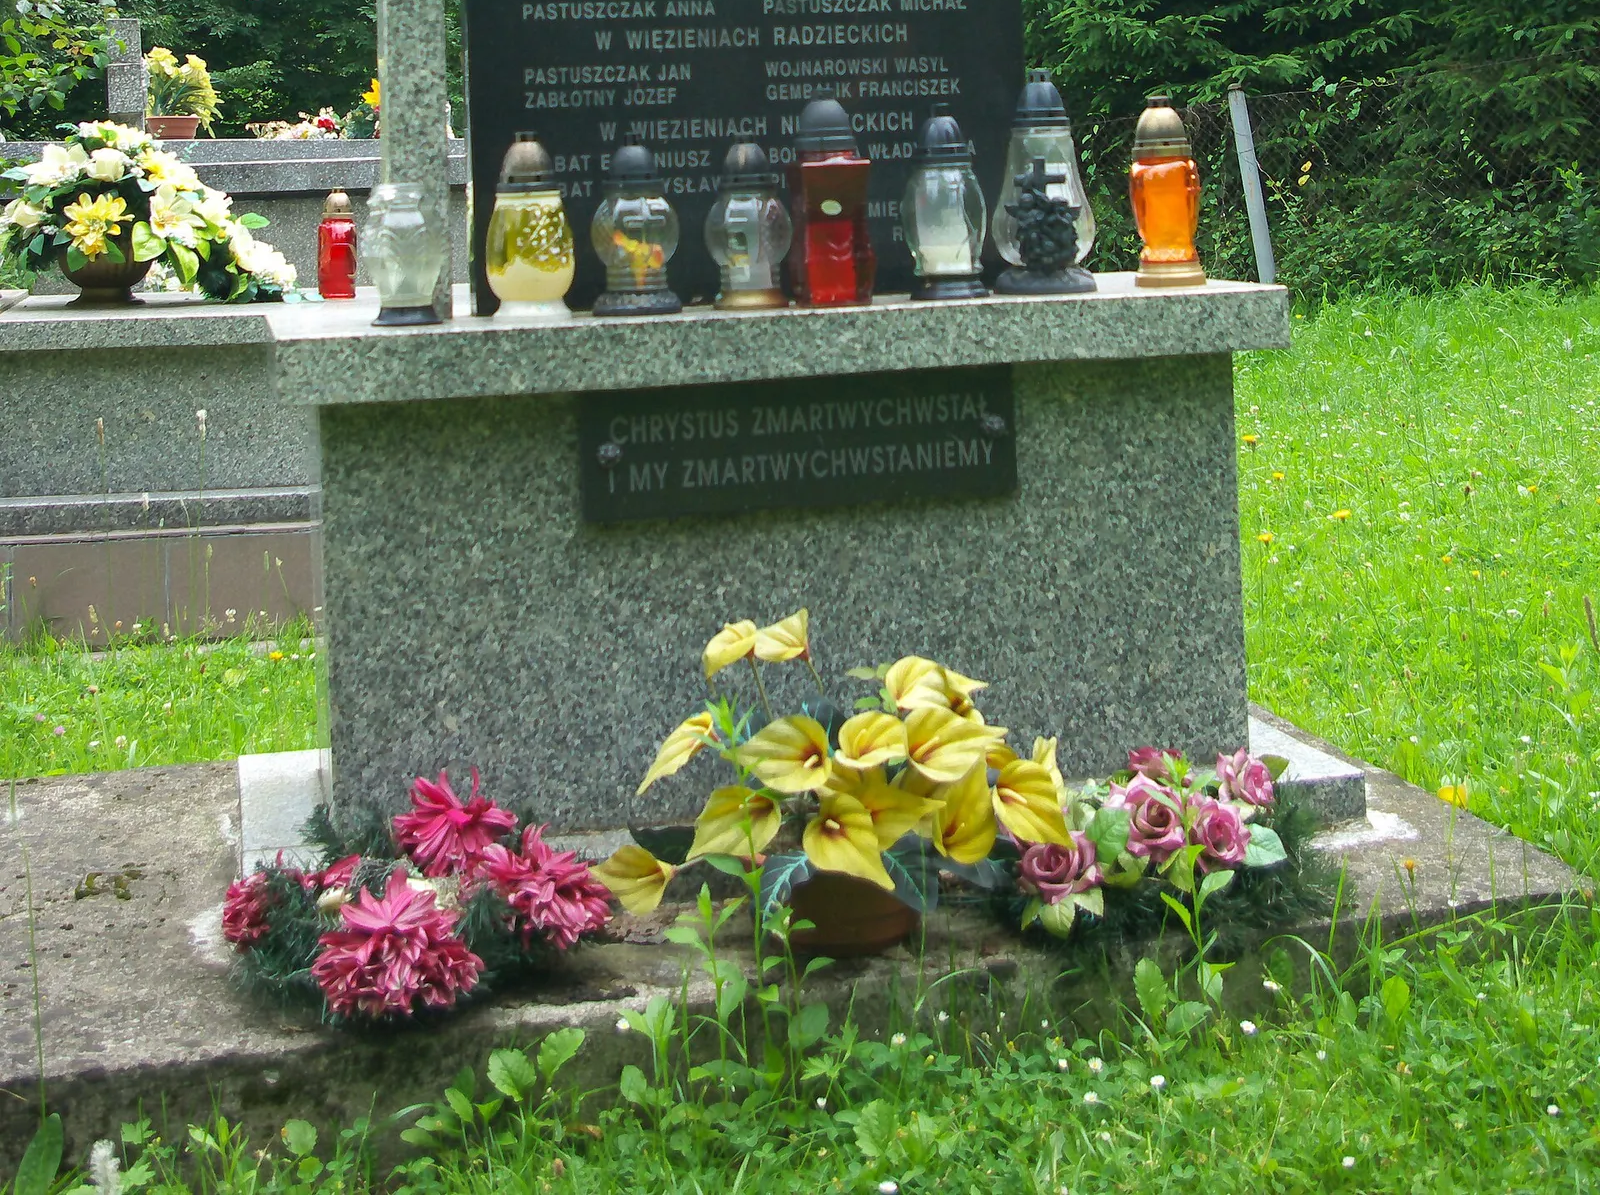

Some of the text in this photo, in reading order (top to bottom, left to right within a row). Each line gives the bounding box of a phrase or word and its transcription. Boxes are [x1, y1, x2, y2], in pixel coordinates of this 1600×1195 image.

[522, 0, 716, 20] PASTUSZCZAK ANNA
[595, 24, 908, 53] W WIĘZIENIACH RADZIECKICH
[524, 64, 691, 84] PASTUSZCZAK JAN
[766, 57, 948, 78] WOJNAROWSKI WASYL
[525, 90, 616, 108] ZABŁOTNY
[859, 78, 960, 98] FRANCISZEK
[601, 112, 913, 144] W WIĘZIENIACH NICKICH
[554, 149, 710, 172] BAT ENIUSZ
[610, 410, 738, 444] CHRYSTUS
[609, 440, 994, 493] I MY ZMARTWYCHWSTANIEMY
